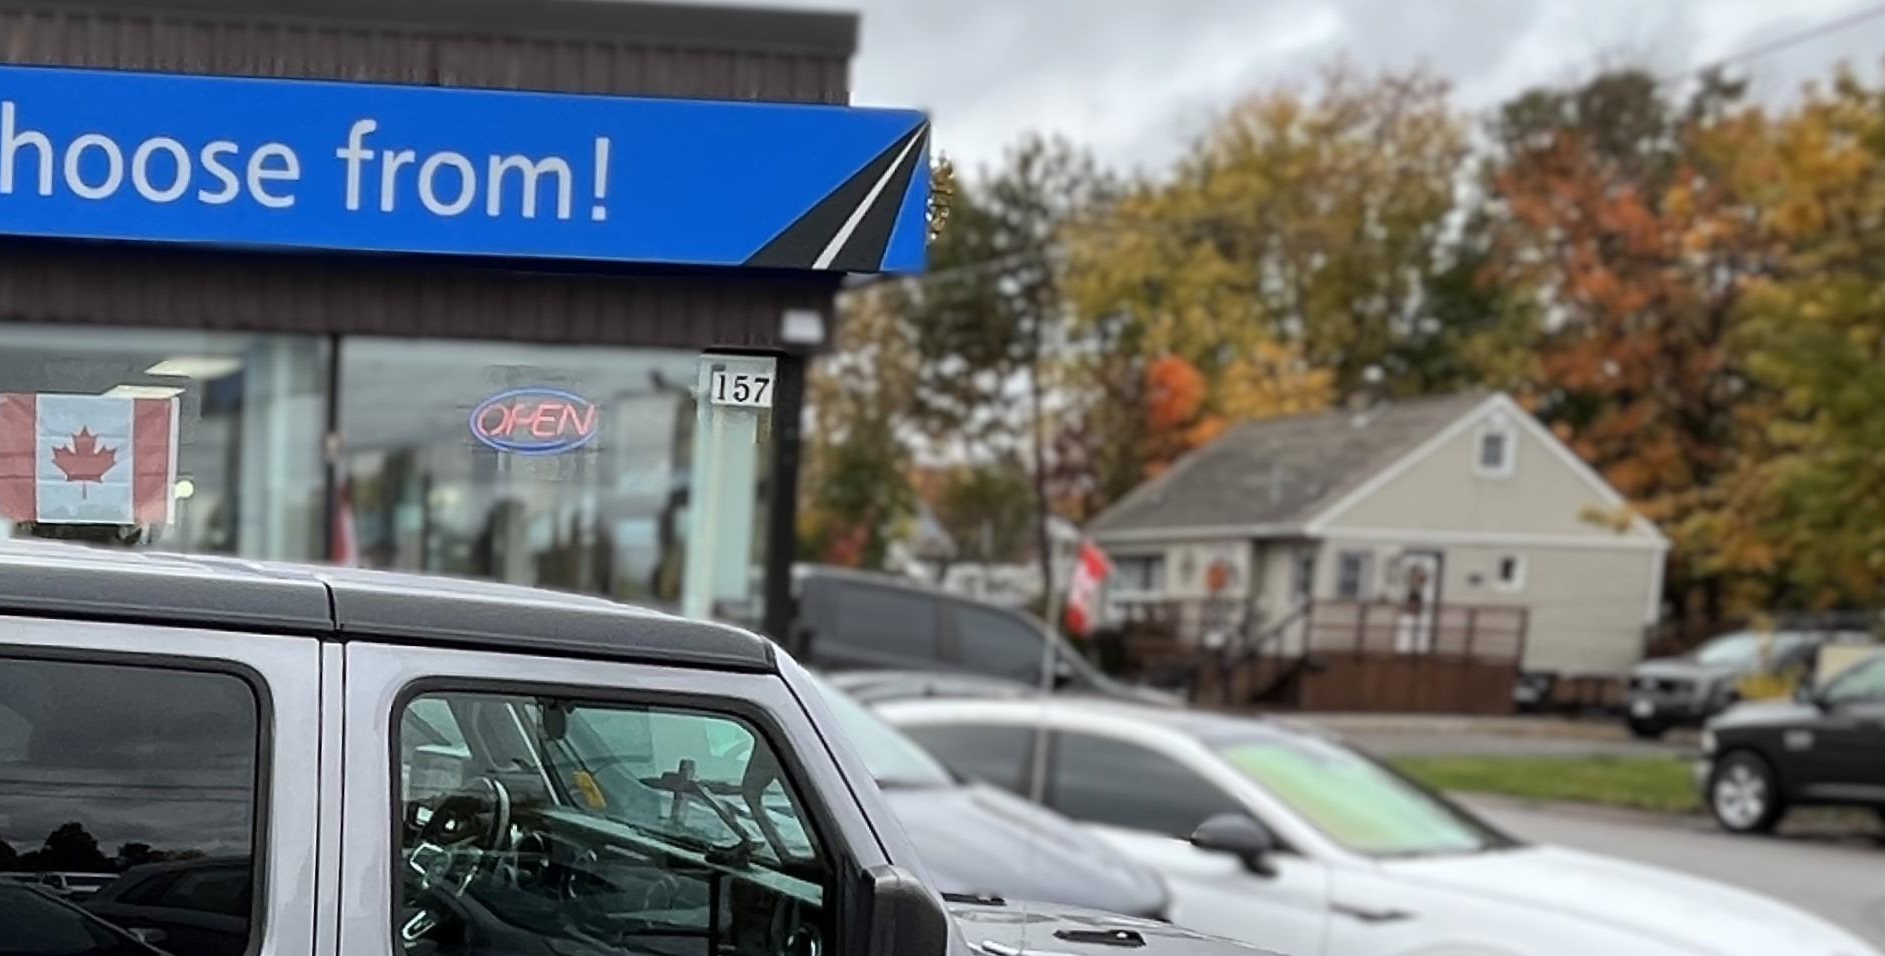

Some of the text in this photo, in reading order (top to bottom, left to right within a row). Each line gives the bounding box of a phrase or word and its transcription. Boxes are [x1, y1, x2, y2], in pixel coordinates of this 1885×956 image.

[335, 118, 611, 220] from!
[715, 373, 770, 402] 157
[476, 402, 595, 437] OPEN
